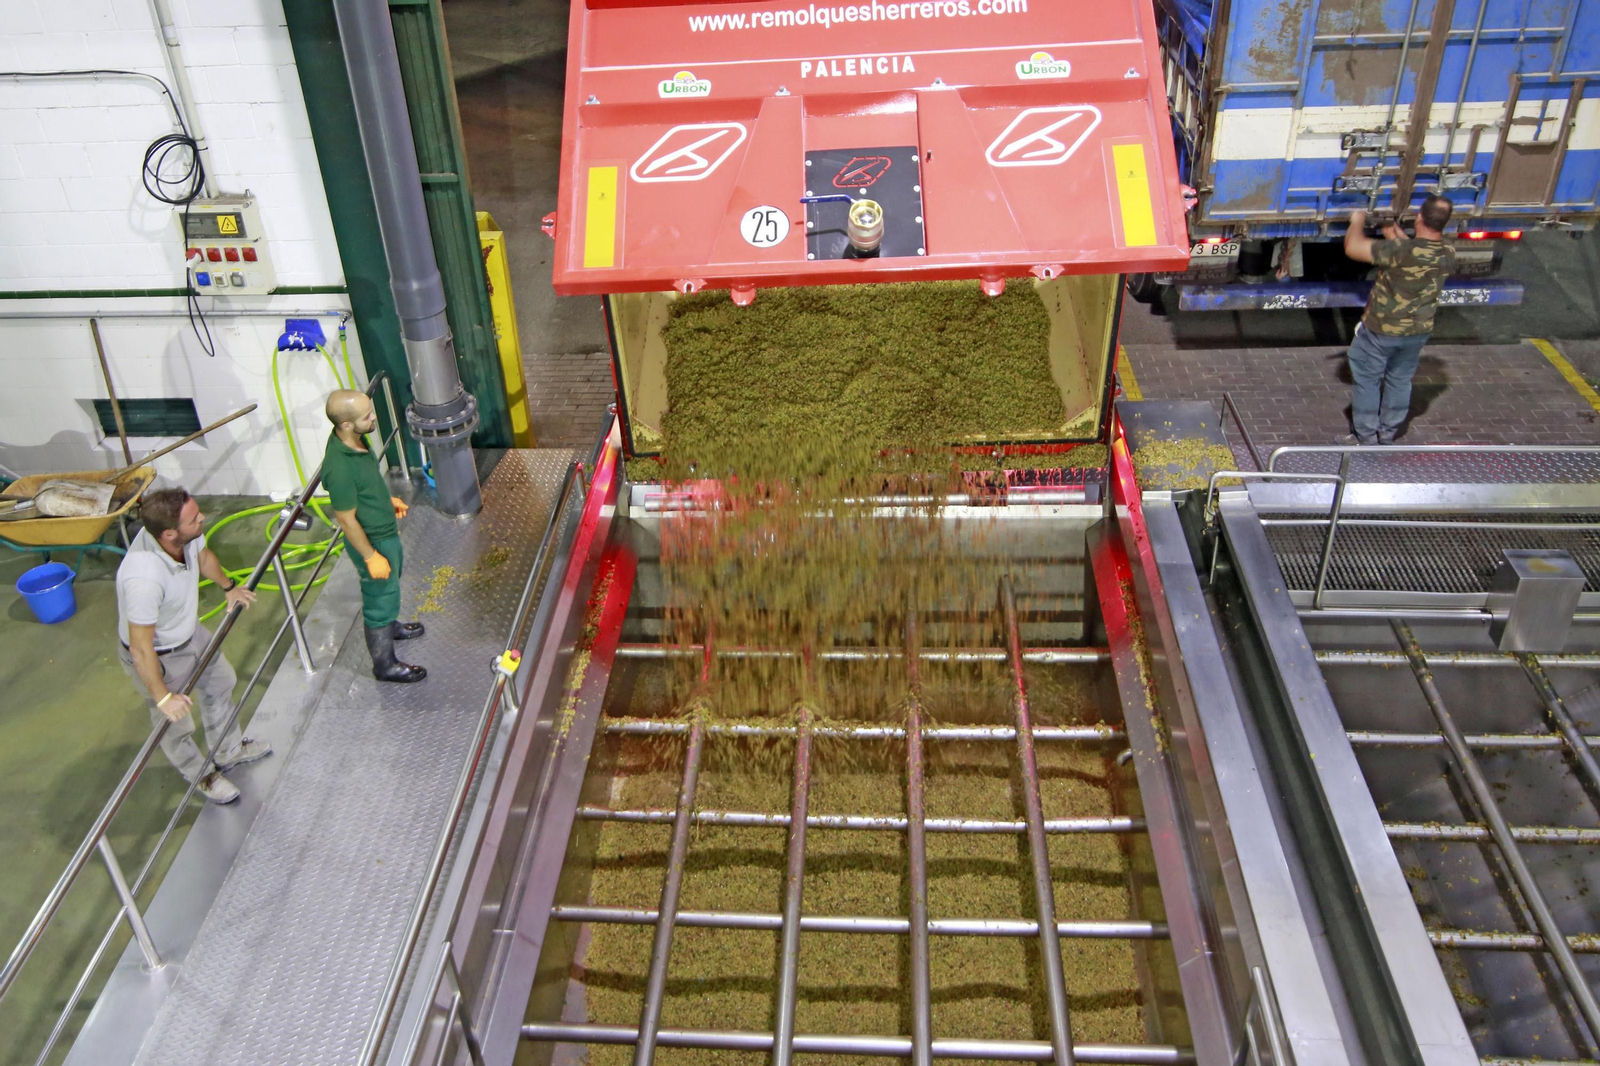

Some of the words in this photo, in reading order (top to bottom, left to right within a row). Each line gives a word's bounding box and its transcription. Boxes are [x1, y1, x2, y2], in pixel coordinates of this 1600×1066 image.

[688, 0, 1028, 32] www.remolquesherreros.com
[801, 56, 915, 78] PALENCIA
[1021, 63, 1066, 74] URBON
[663, 82, 707, 93] URBON
[752, 210, 778, 243] 25
[1211, 244, 1237, 254] BSP
